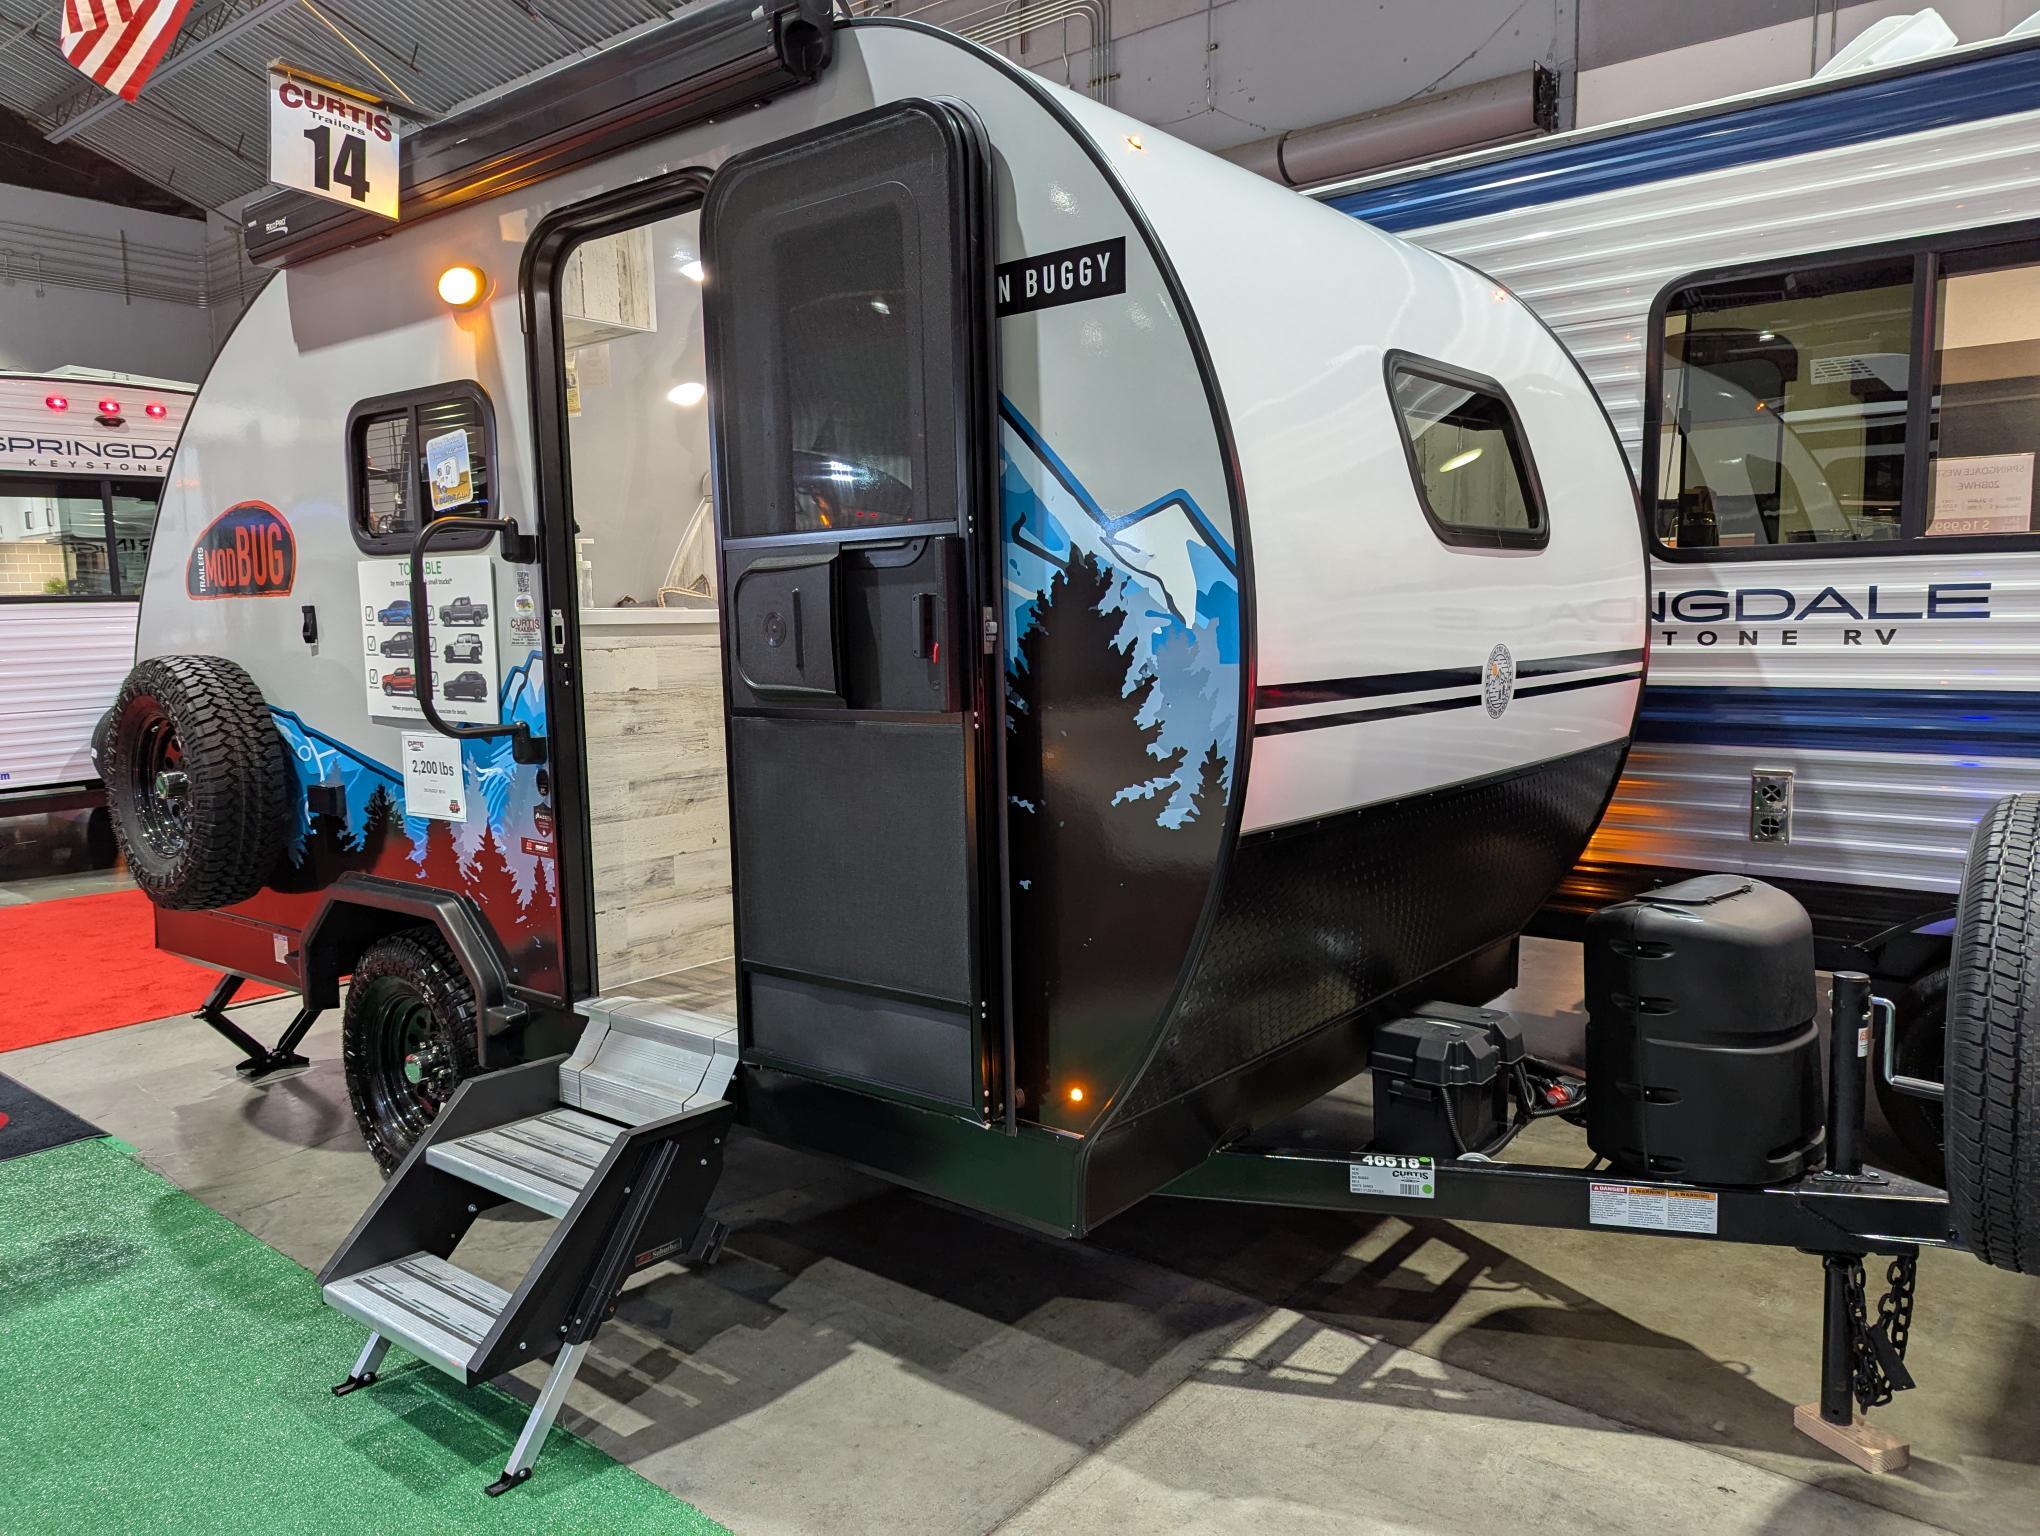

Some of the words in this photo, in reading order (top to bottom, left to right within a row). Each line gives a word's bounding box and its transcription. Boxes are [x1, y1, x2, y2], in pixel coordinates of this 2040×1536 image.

[279, 83, 392, 142] CURTIS
[309, 110, 367, 136] Trailers
[303, 125, 370, 203] 14
[1025, 252, 1111, 298] BUGGY
[29, 458, 163, 473] KEYSTONE
[197, 547, 207, 592] TRAILERS
[510, 618, 540, 629] CURTIS
[1843, 629, 1898, 646] RV
[412, 759, 438, 776] 2,200
[440, 761, 455, 776] lbs
[1362, 1155, 1420, 1169] 46518
[1392, 1170, 1429, 1180] CURTIS
